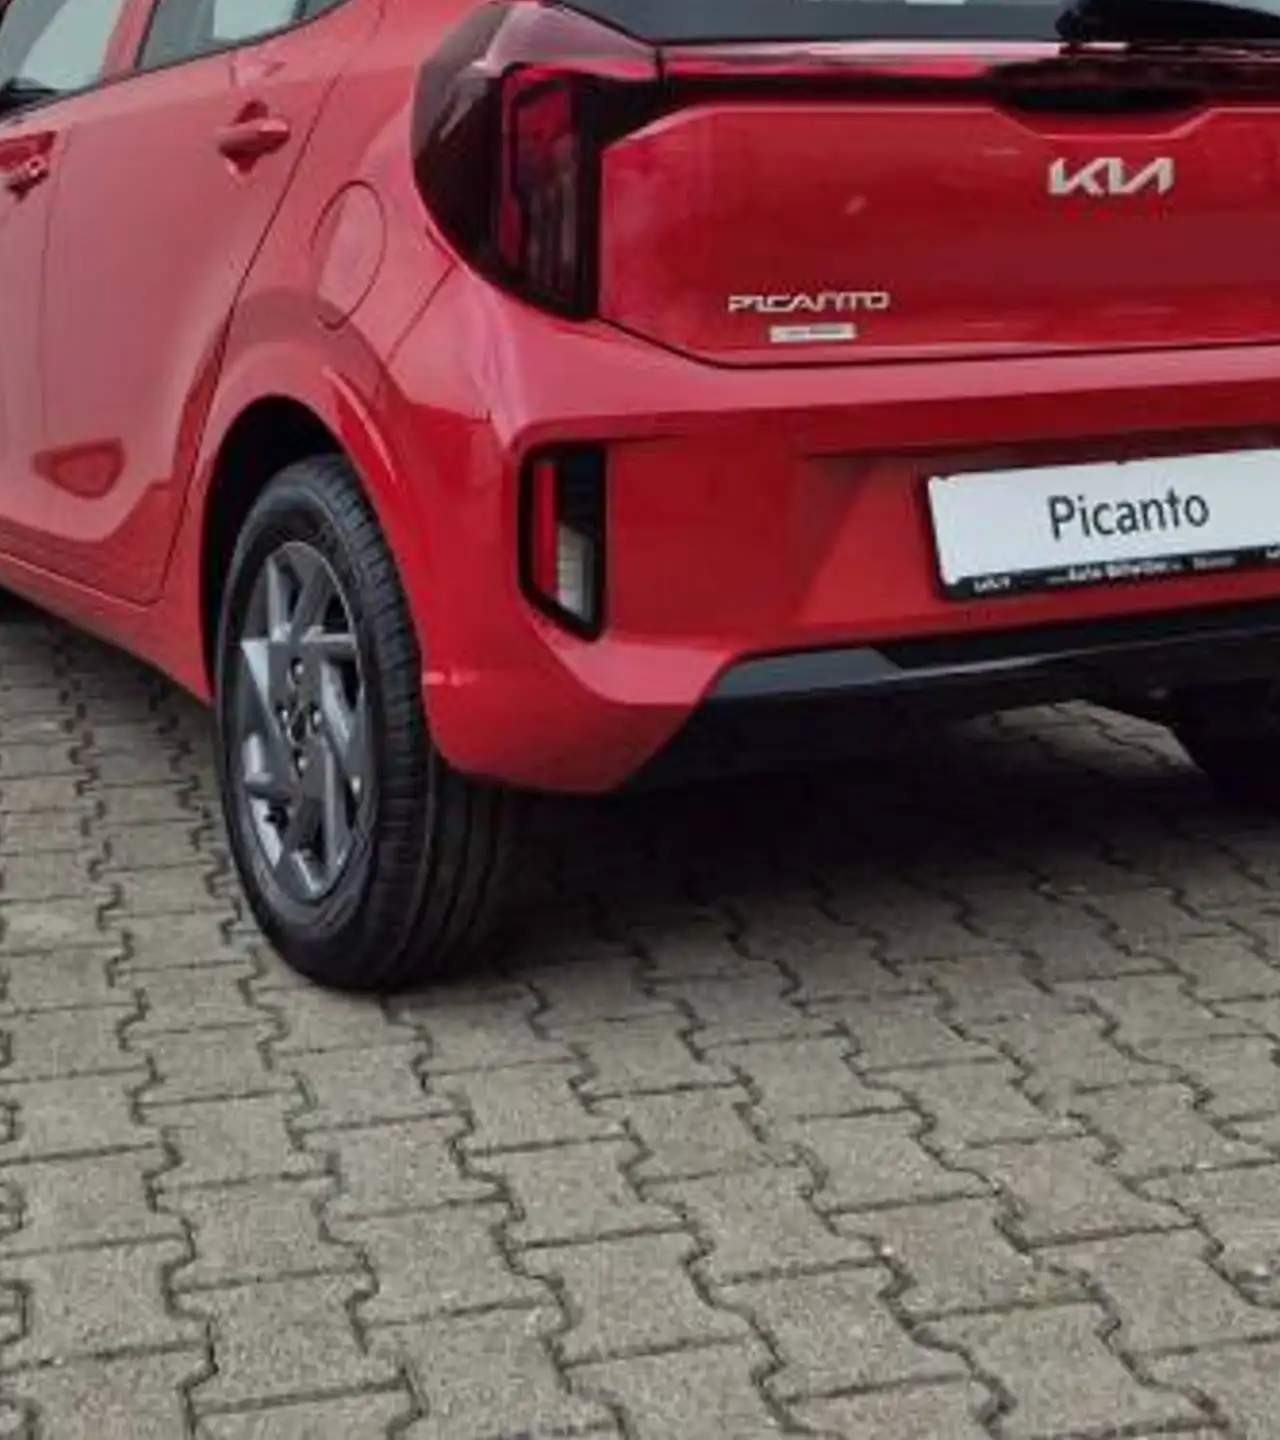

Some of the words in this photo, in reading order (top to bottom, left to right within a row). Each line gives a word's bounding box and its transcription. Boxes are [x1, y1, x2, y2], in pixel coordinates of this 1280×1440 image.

[1050, 157, 1175, 196] KIA
[728, 290, 891, 313] PICANTO
[1048, 486, 1210, 541] Picanto
